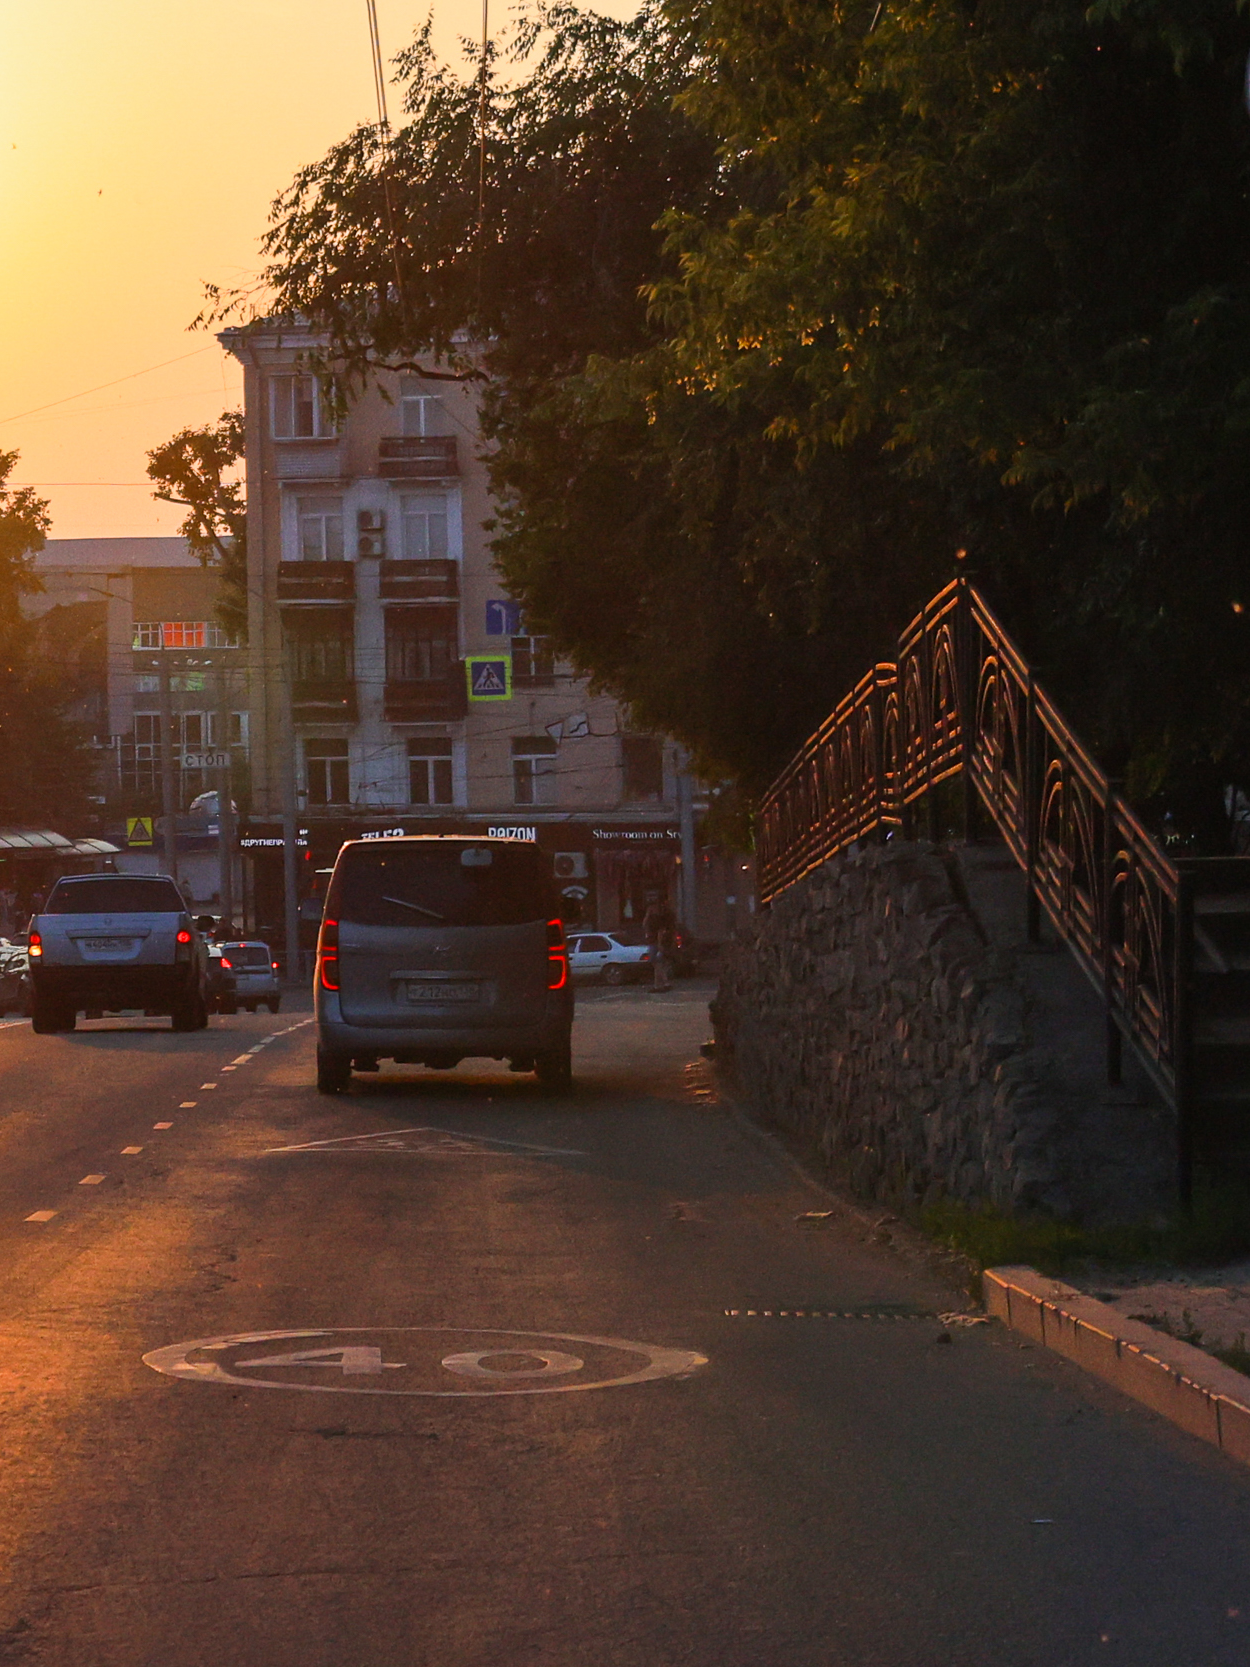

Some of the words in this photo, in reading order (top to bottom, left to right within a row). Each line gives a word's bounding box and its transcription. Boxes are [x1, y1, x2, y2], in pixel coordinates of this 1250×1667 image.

[185, 754, 225, 767] СТОП
[592, 828, 647, 840] Showroom
[649, 831, 663, 840] on
[235, 1346, 584, 1379] 40
